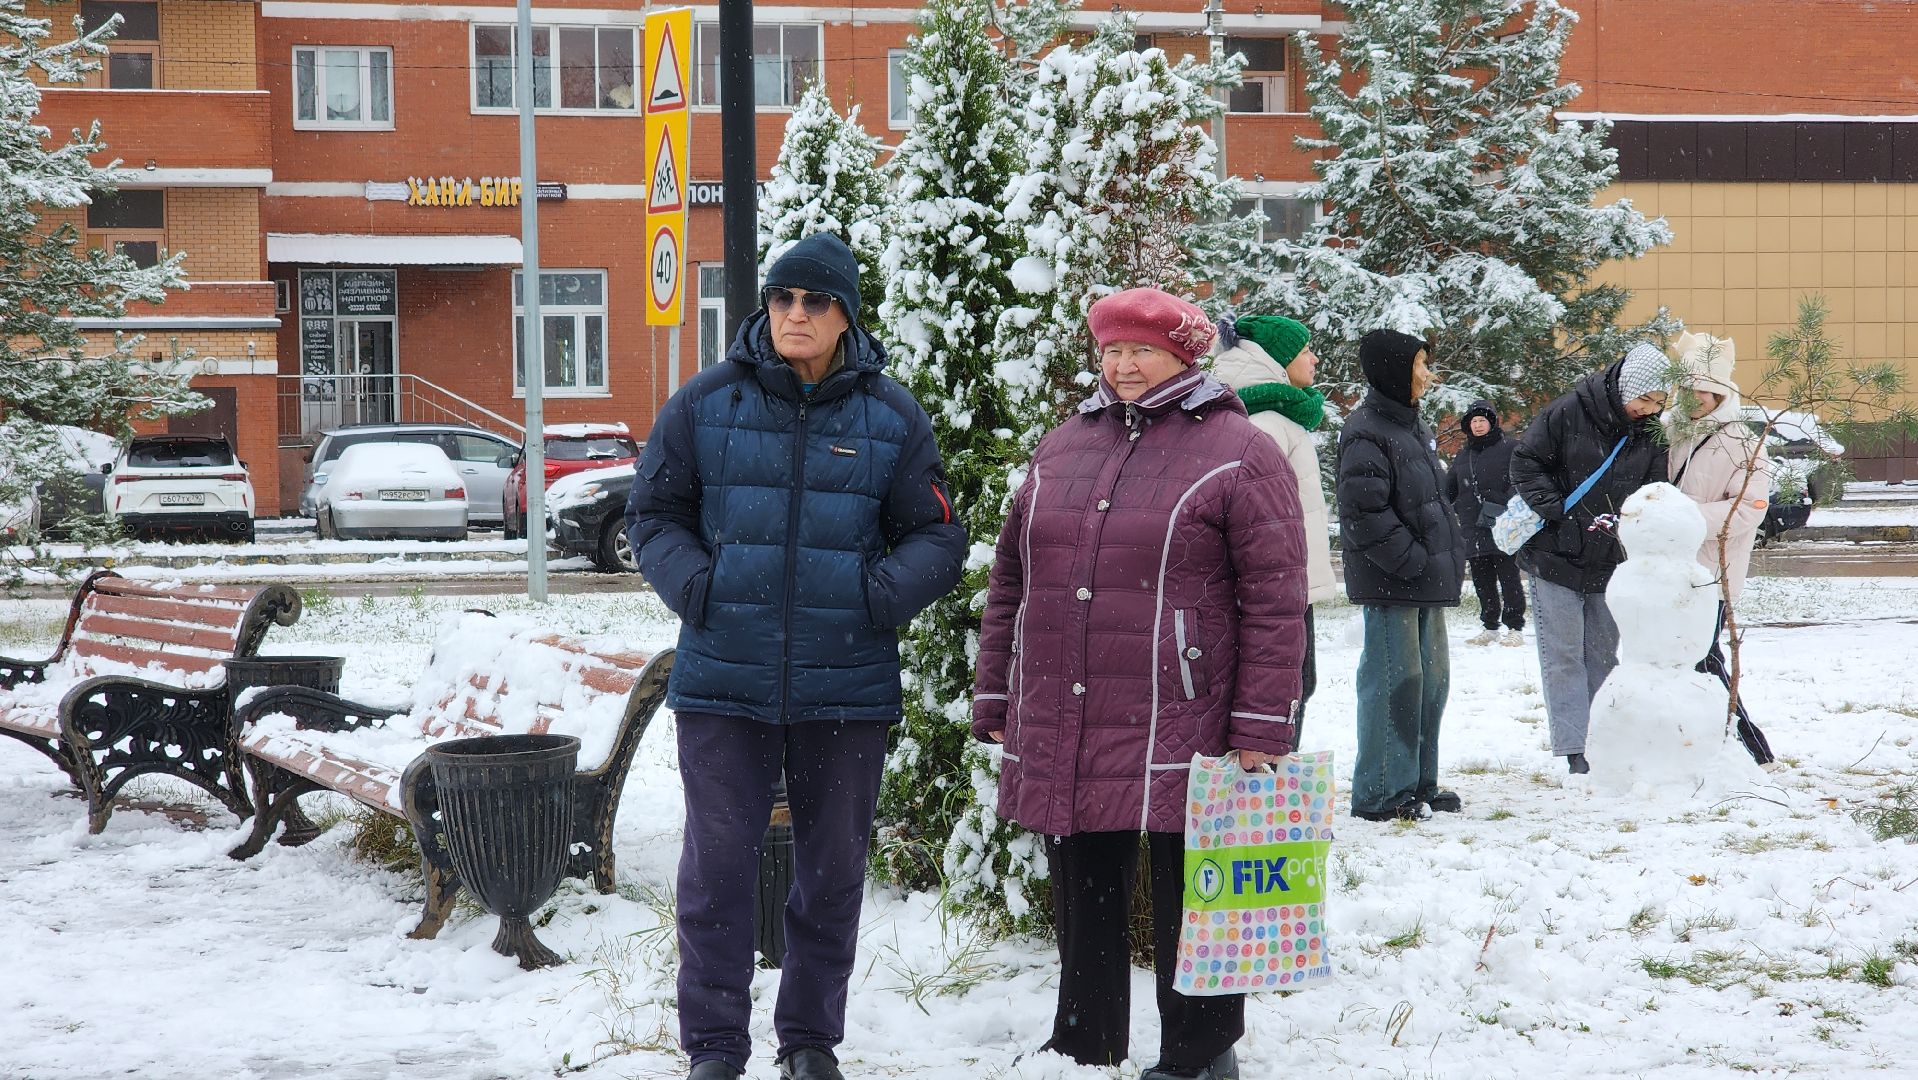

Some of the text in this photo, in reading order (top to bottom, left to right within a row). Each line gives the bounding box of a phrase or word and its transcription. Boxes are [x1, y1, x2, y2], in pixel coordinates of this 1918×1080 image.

[656, 250, 671, 284] 40
[344, 280, 385, 288] МАГАЗИН
[338, 287, 391, 295] РАЗЛИВНЫХ
